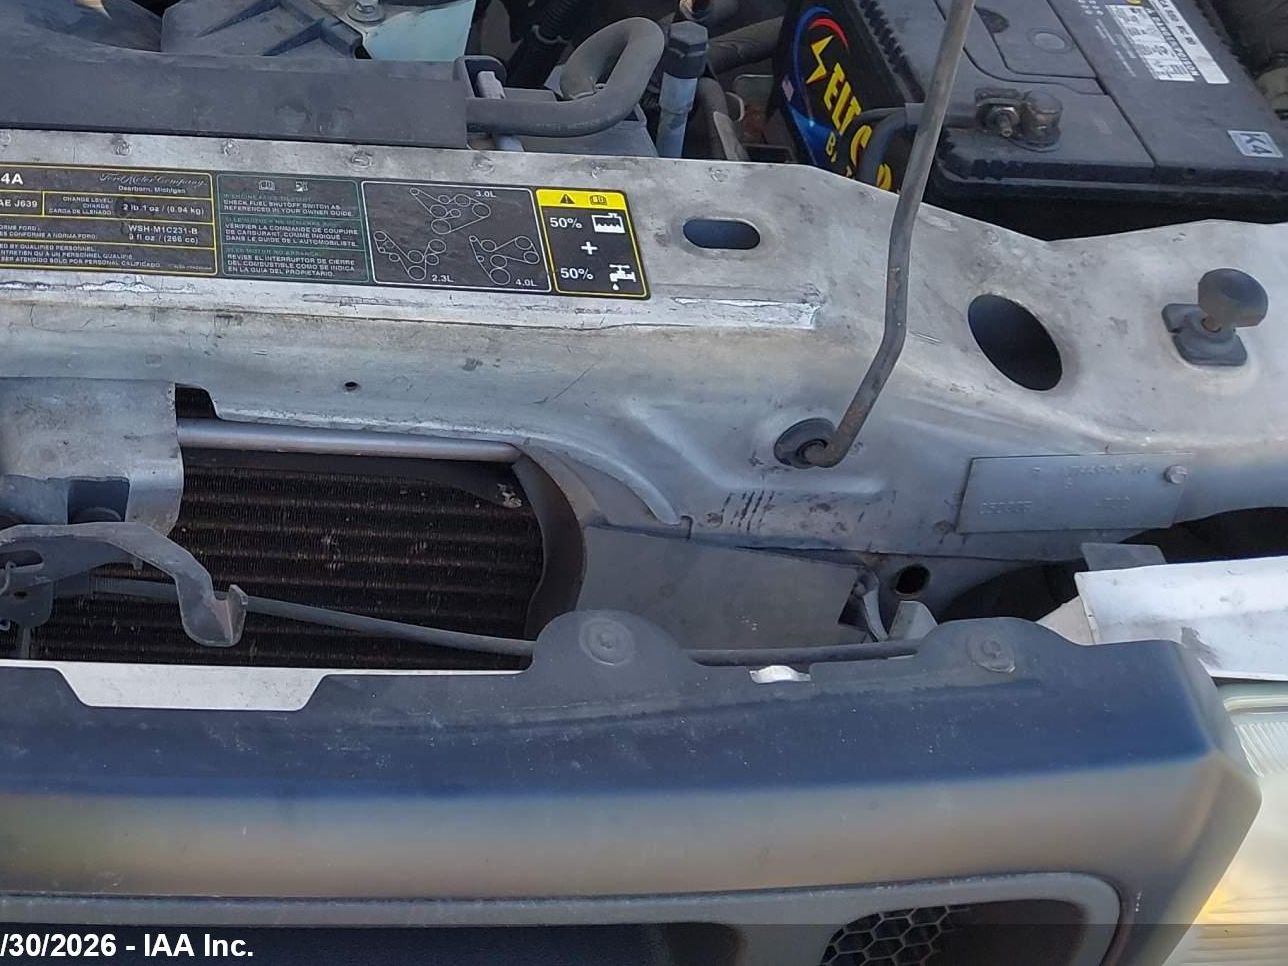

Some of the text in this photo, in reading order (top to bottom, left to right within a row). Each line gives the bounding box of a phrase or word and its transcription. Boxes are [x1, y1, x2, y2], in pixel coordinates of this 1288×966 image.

[1239, 132, 1273, 154] K4
[476, 190, 496, 198] 3.0L
[14, 199, 38, 208] J639
[190, 207, 204, 216] kg)
[550, 217, 582, 229] 50%
[128, 224, 198, 235] WSH-M1C231-B
[185, 236, 198, 244] cc)
[432, 274, 454, 282] 2.3L
[560, 268, 594, 280] 50%
[515, 278, 538, 286] 4.0L
